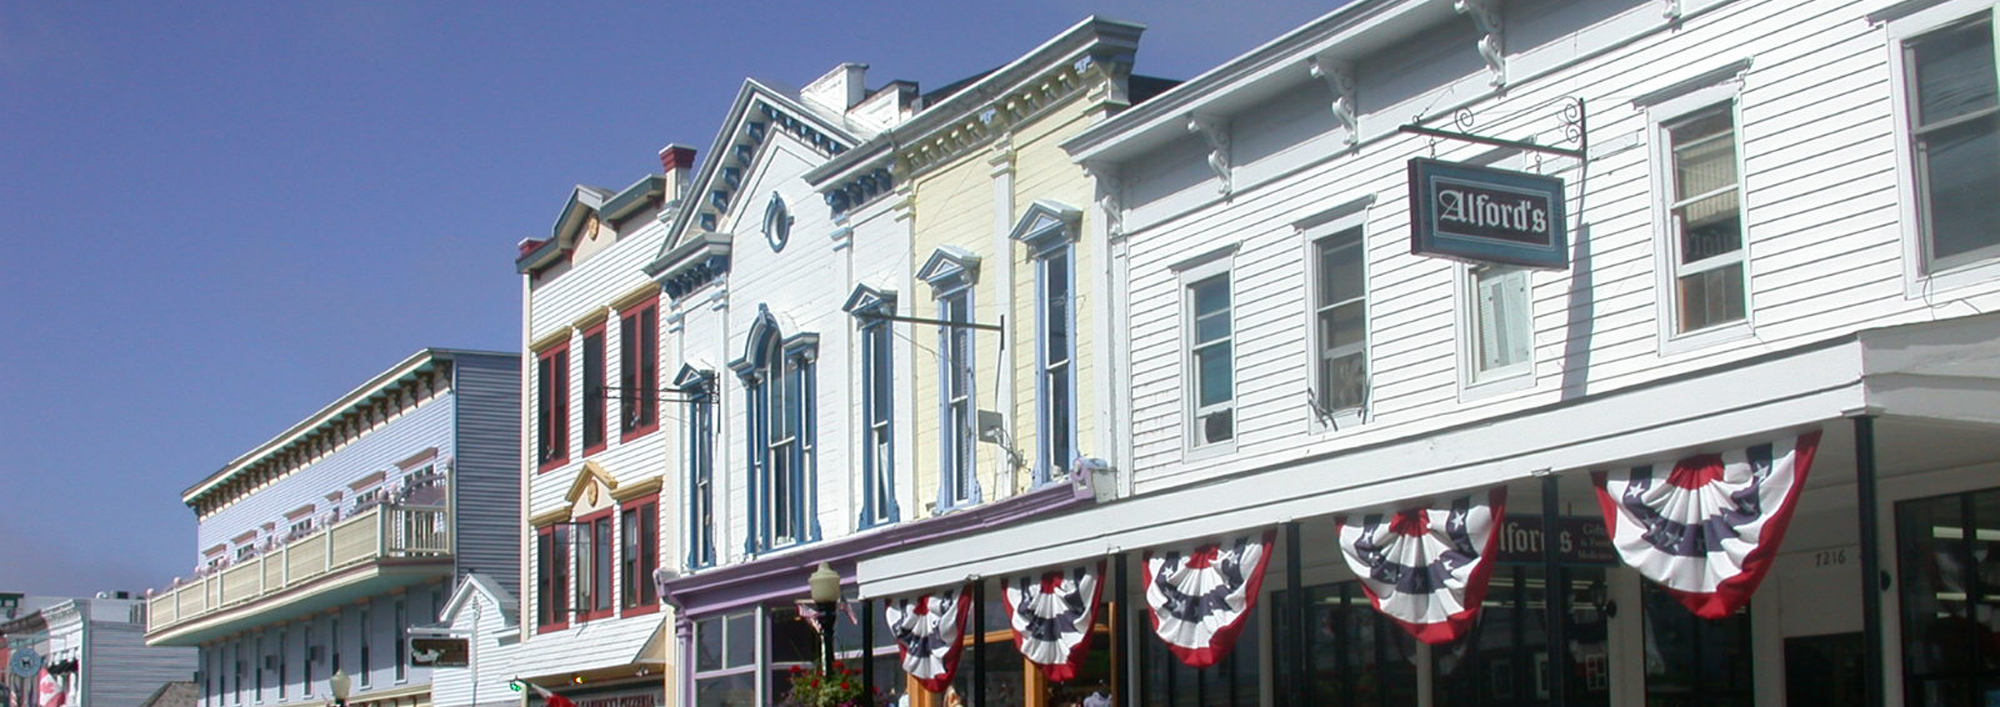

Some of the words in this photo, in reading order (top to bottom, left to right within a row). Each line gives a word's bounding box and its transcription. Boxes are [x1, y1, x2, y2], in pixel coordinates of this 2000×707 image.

[1438, 189, 1547, 233] Alford's
[1815, 549, 1846, 567] 7216
[620, 693, 654, 707] PIZZERIA
